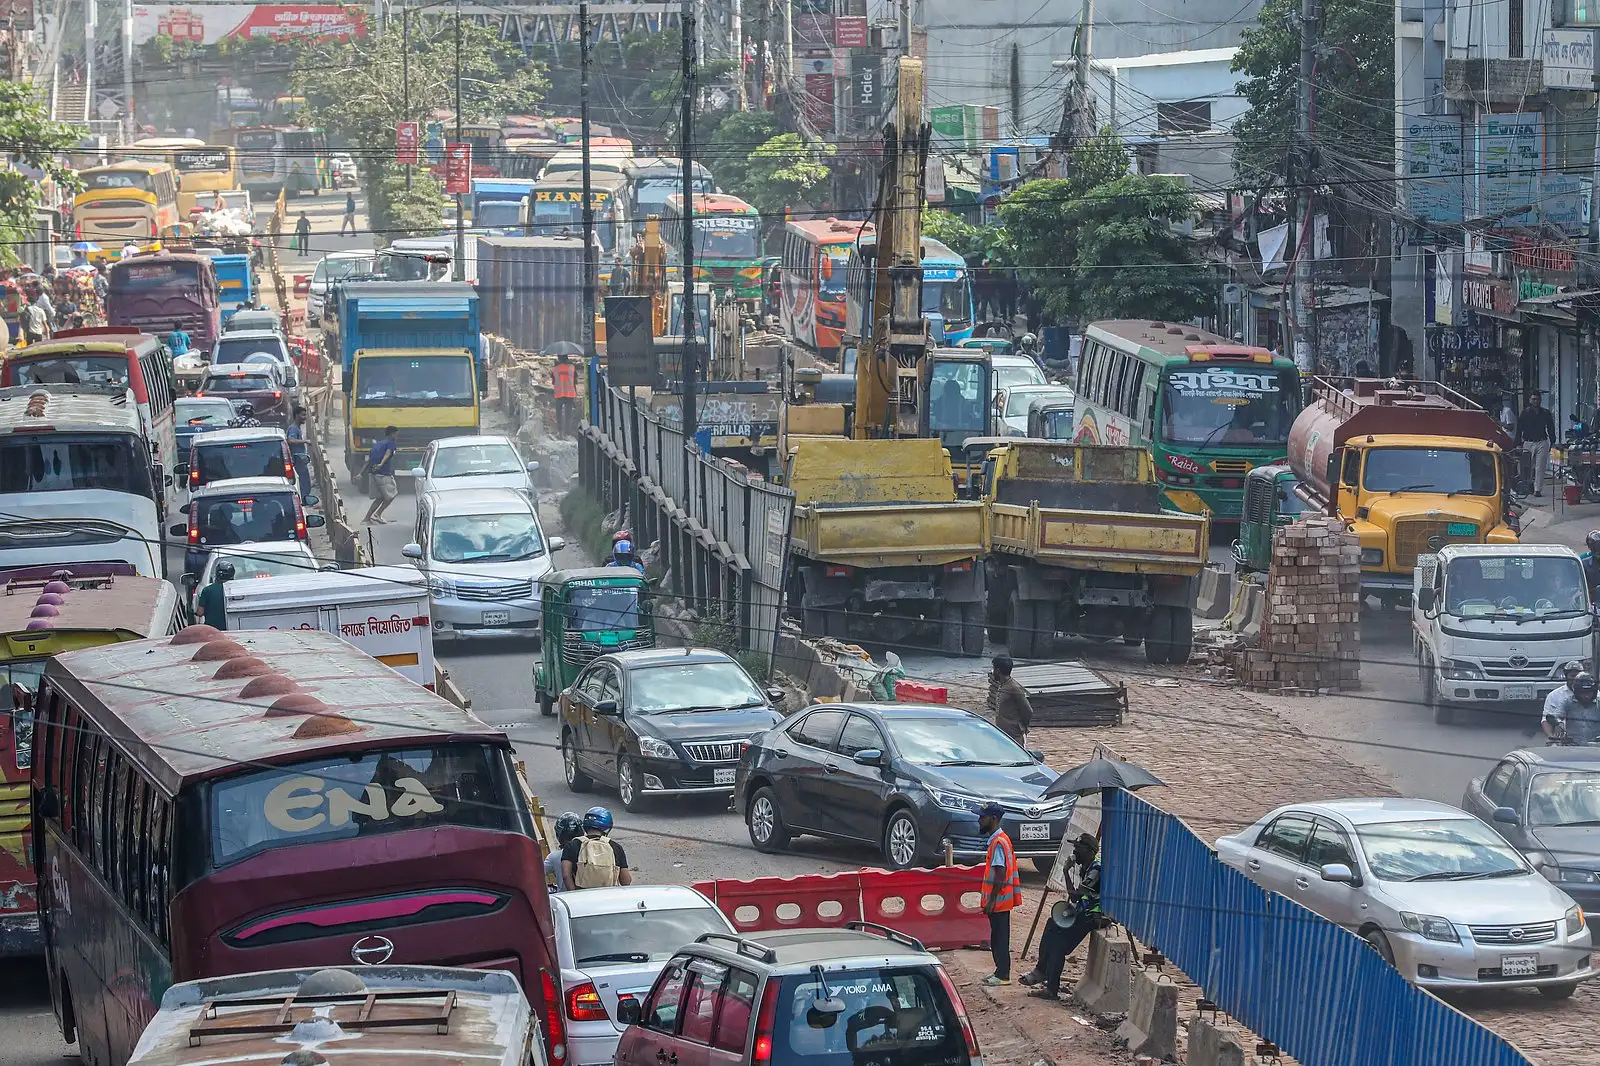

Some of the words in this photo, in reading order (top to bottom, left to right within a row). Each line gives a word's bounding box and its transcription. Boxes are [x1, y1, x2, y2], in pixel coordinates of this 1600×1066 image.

[861, 67, 873, 105] Haier
[535, 191, 608, 202] HANF
[1468, 281, 1493, 310] TOFAYEL
[1169, 456, 1199, 473] Raida
[569, 579, 596, 588] OBHAI
[341, 622, 367, 637] কাজে
[367, 614, 412, 636] নিয়োজিত
[844, 985, 867, 995] YOKO
[871, 983, 893, 993] AMA
